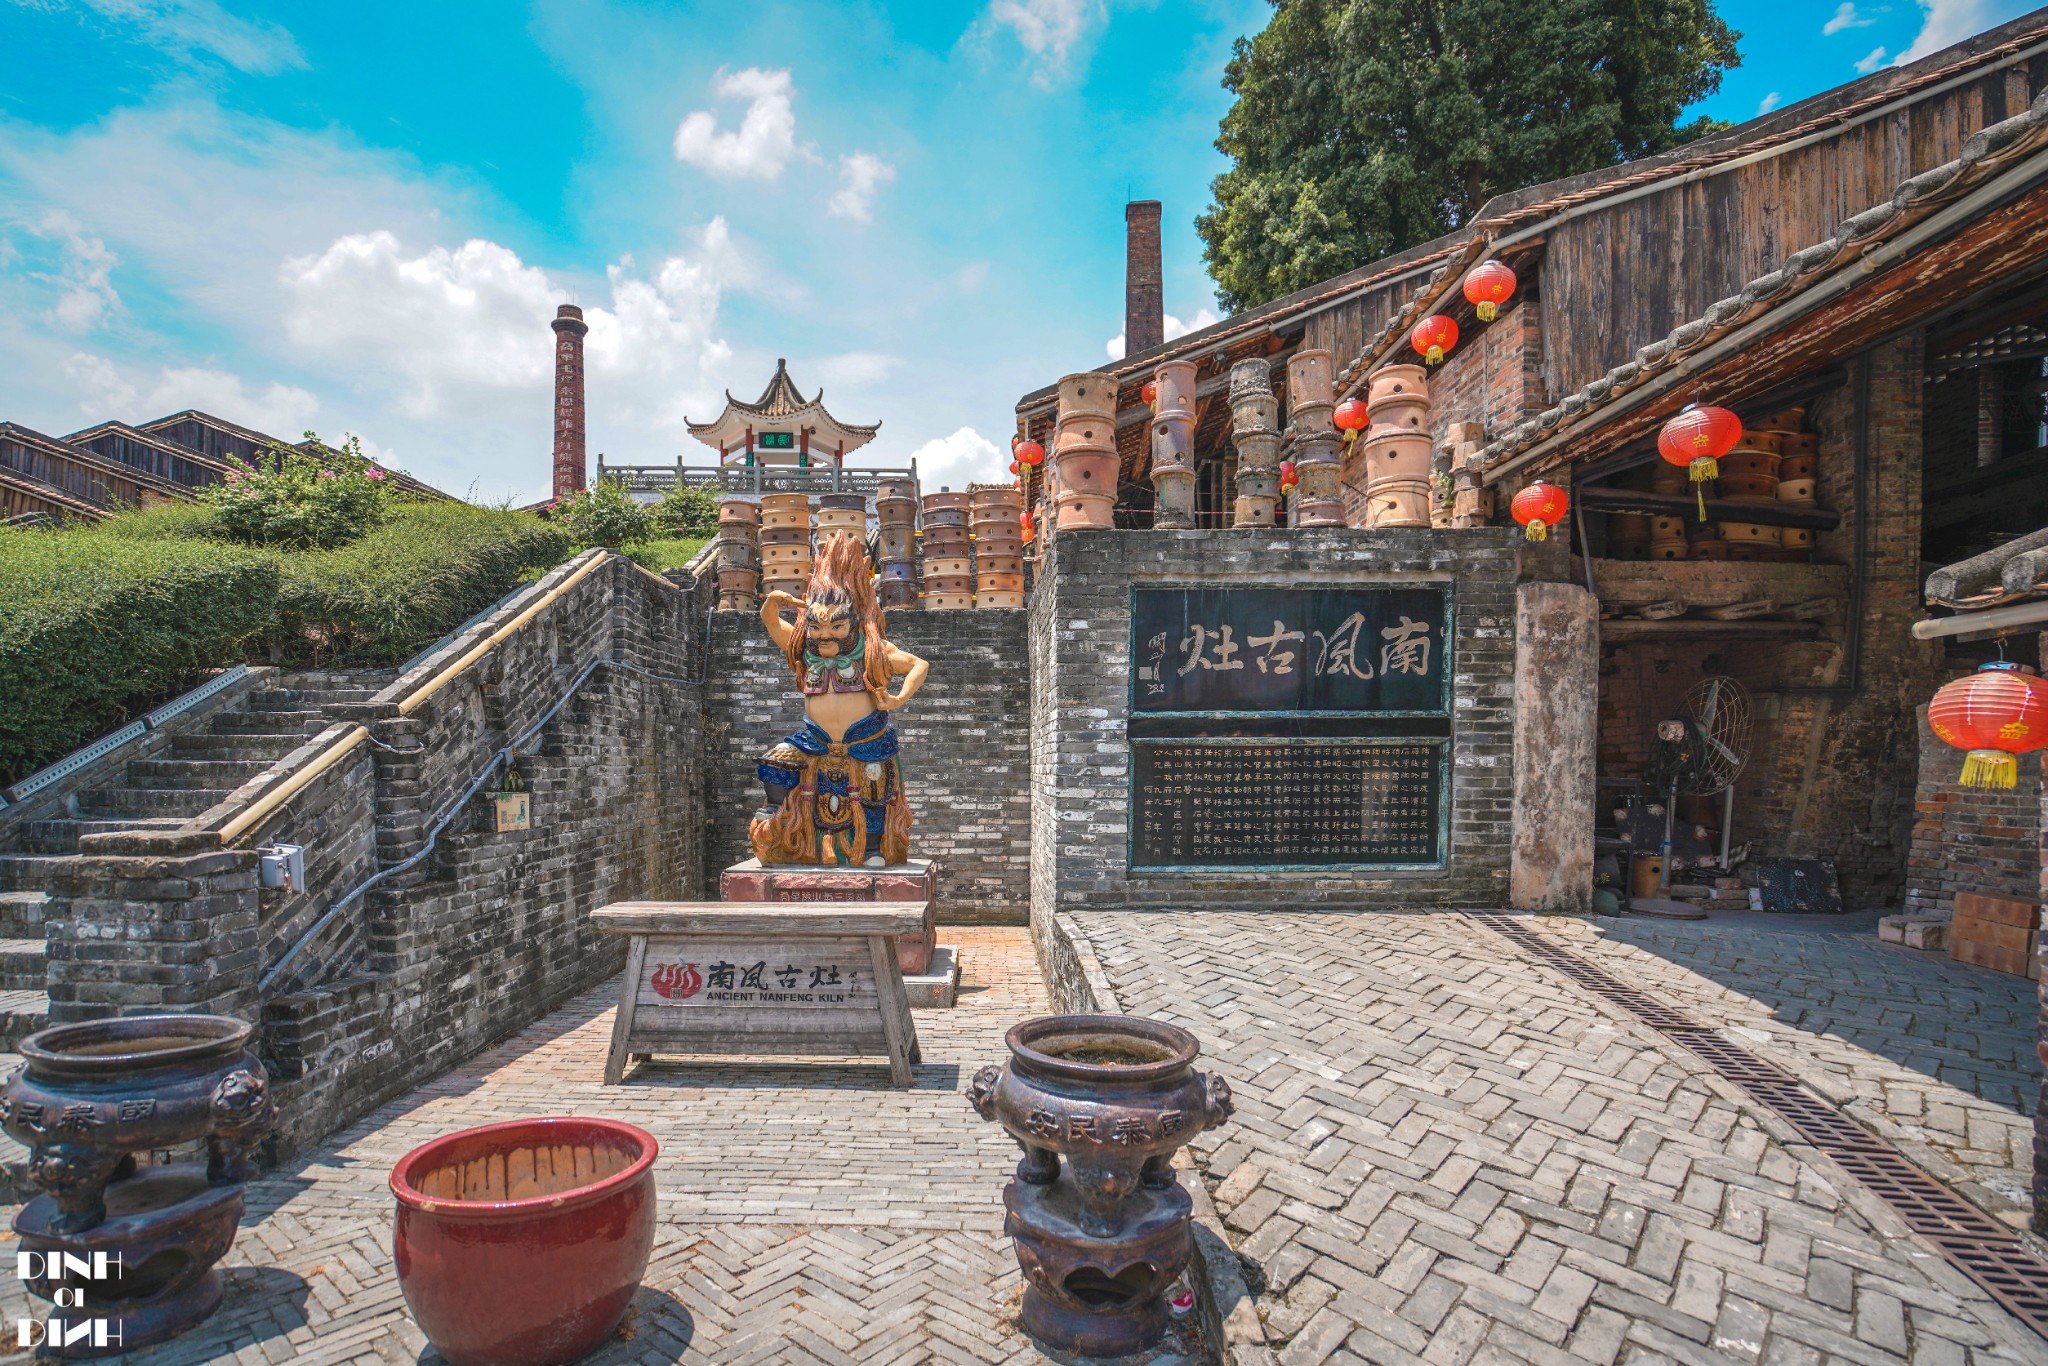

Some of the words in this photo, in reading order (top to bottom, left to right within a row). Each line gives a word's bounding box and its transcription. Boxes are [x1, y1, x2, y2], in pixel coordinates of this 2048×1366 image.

[706, 991, 755, 1001] ANCIENT
[760, 992, 814, 1002] NANFENG
[818, 993, 845, 1003] KILN
